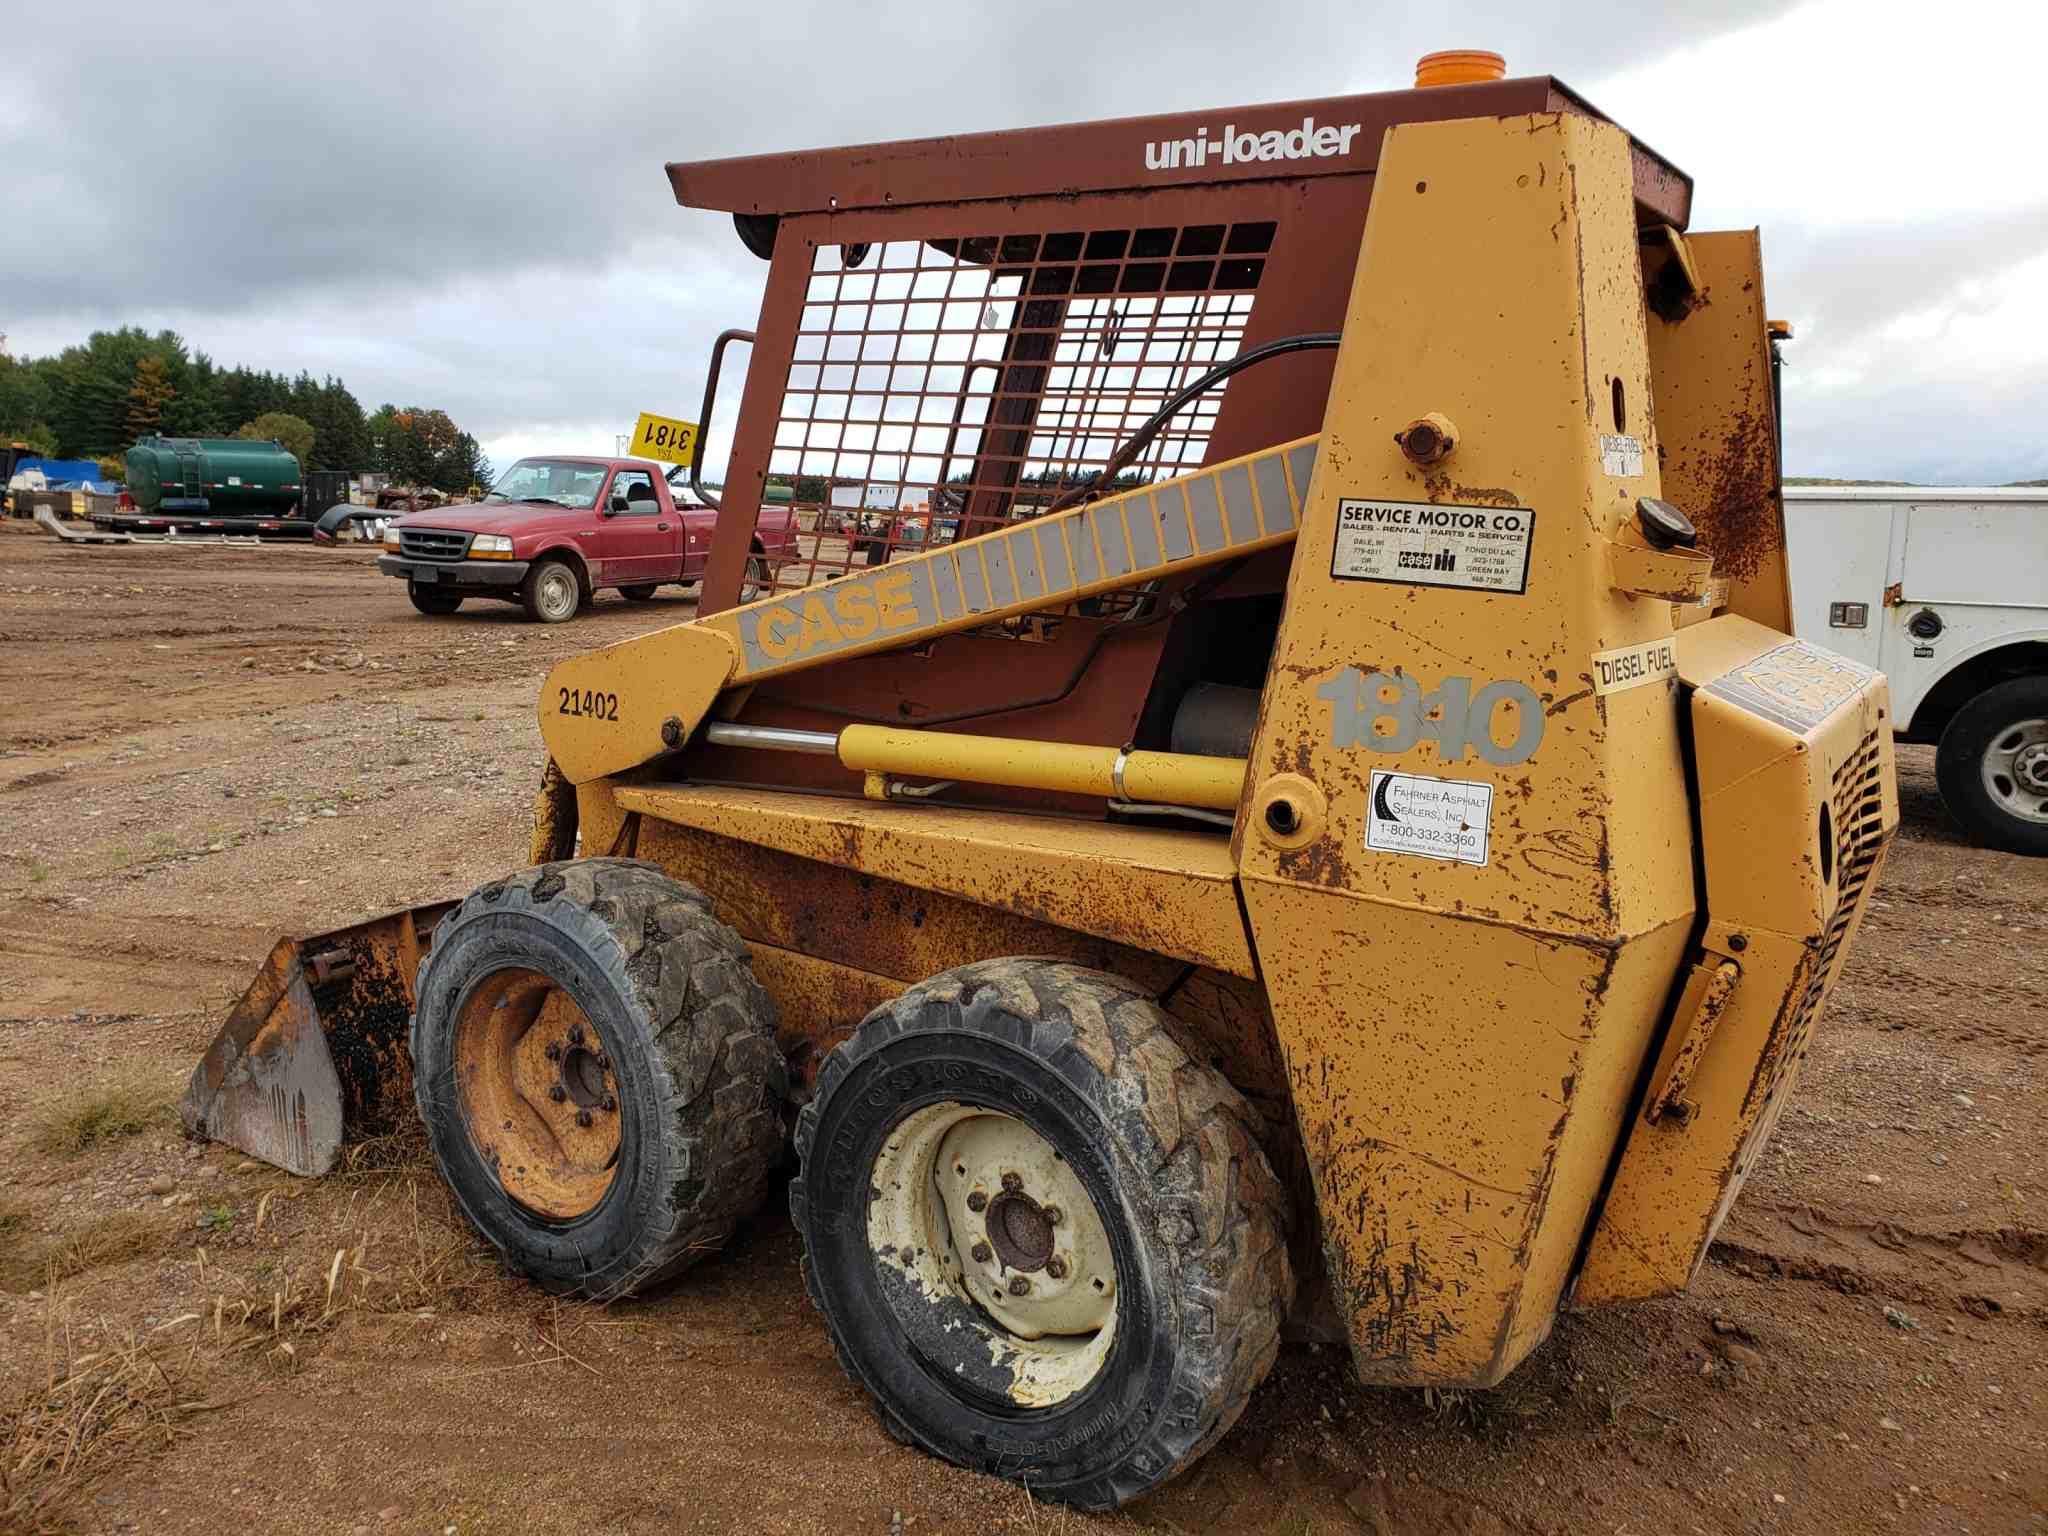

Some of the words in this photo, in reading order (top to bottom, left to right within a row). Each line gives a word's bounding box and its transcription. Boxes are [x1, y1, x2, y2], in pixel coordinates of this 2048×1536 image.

[1145, 116, 1361, 170] uni-loader
[644, 422, 691, 450] 3181
[1343, 522, 1374, 532] SALES
[1382, 525, 1421, 535] RENTAL
[1430, 528, 1465, 538] PARTS
[1478, 531, 1523, 542] SERVICE
[1344, 506, 1412, 524] SERVICE
[1418, 511, 1485, 529] MOTOR
[1492, 516, 1526, 532] CO.
[1500, 548, 1516, 557] LAC
[1466, 565, 1493, 575] GREEN
[1494, 567, 1510, 575] BAY
[757, 570, 919, 660] CASE
[1601, 654, 1646, 685] DIESEL
[1648, 647, 1676, 673] FUEL
[559, 687, 619, 722] 21402
[1317, 665, 1546, 768] 1810
[1393, 784, 1439, 801] FAHRNER
[1441, 791, 1487, 808] ASPHALT
[1380, 822, 1476, 847] 1-800-332-3360
